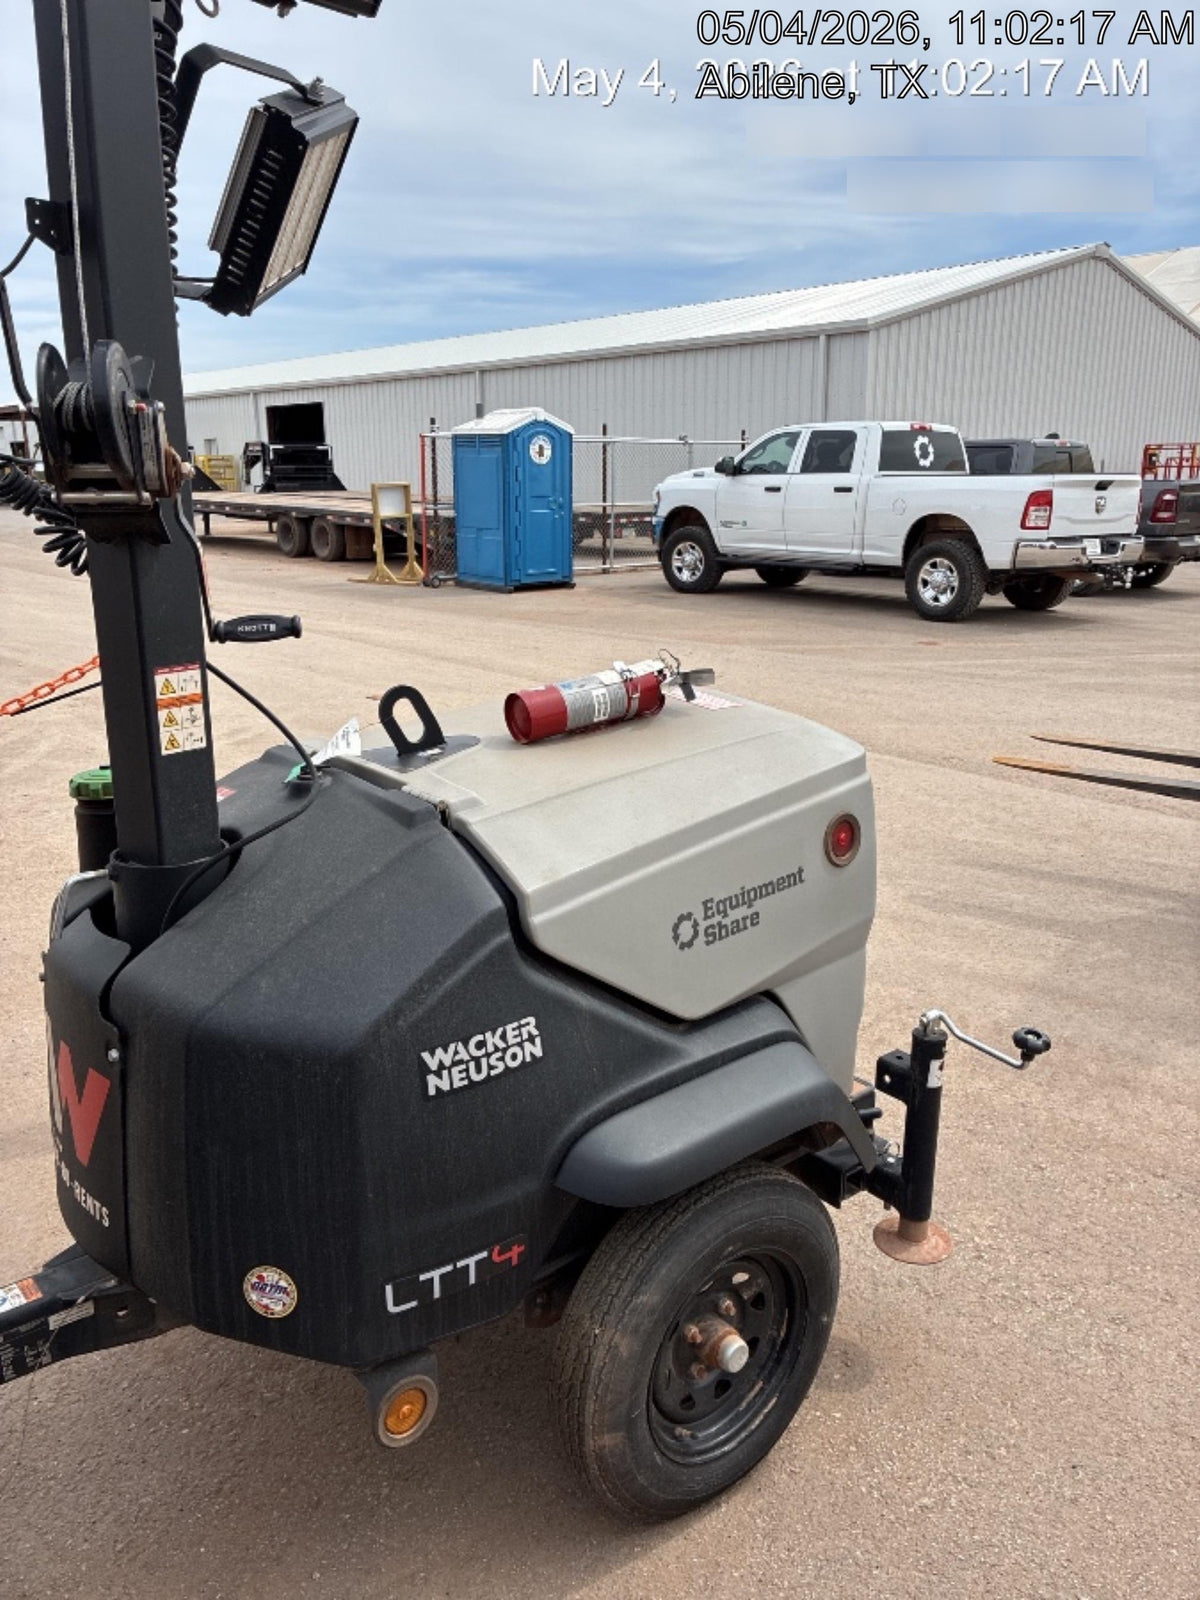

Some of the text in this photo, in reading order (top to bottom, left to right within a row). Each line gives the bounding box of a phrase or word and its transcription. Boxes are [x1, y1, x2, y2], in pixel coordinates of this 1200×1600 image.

[701, 866, 806, 921] Equipment
[703, 911, 761, 947] Share
[420, 1016, 540, 1072] WACKER
[425, 1036, 543, 1097] NEUSON
[385, 1243, 526, 1314] LTT4
